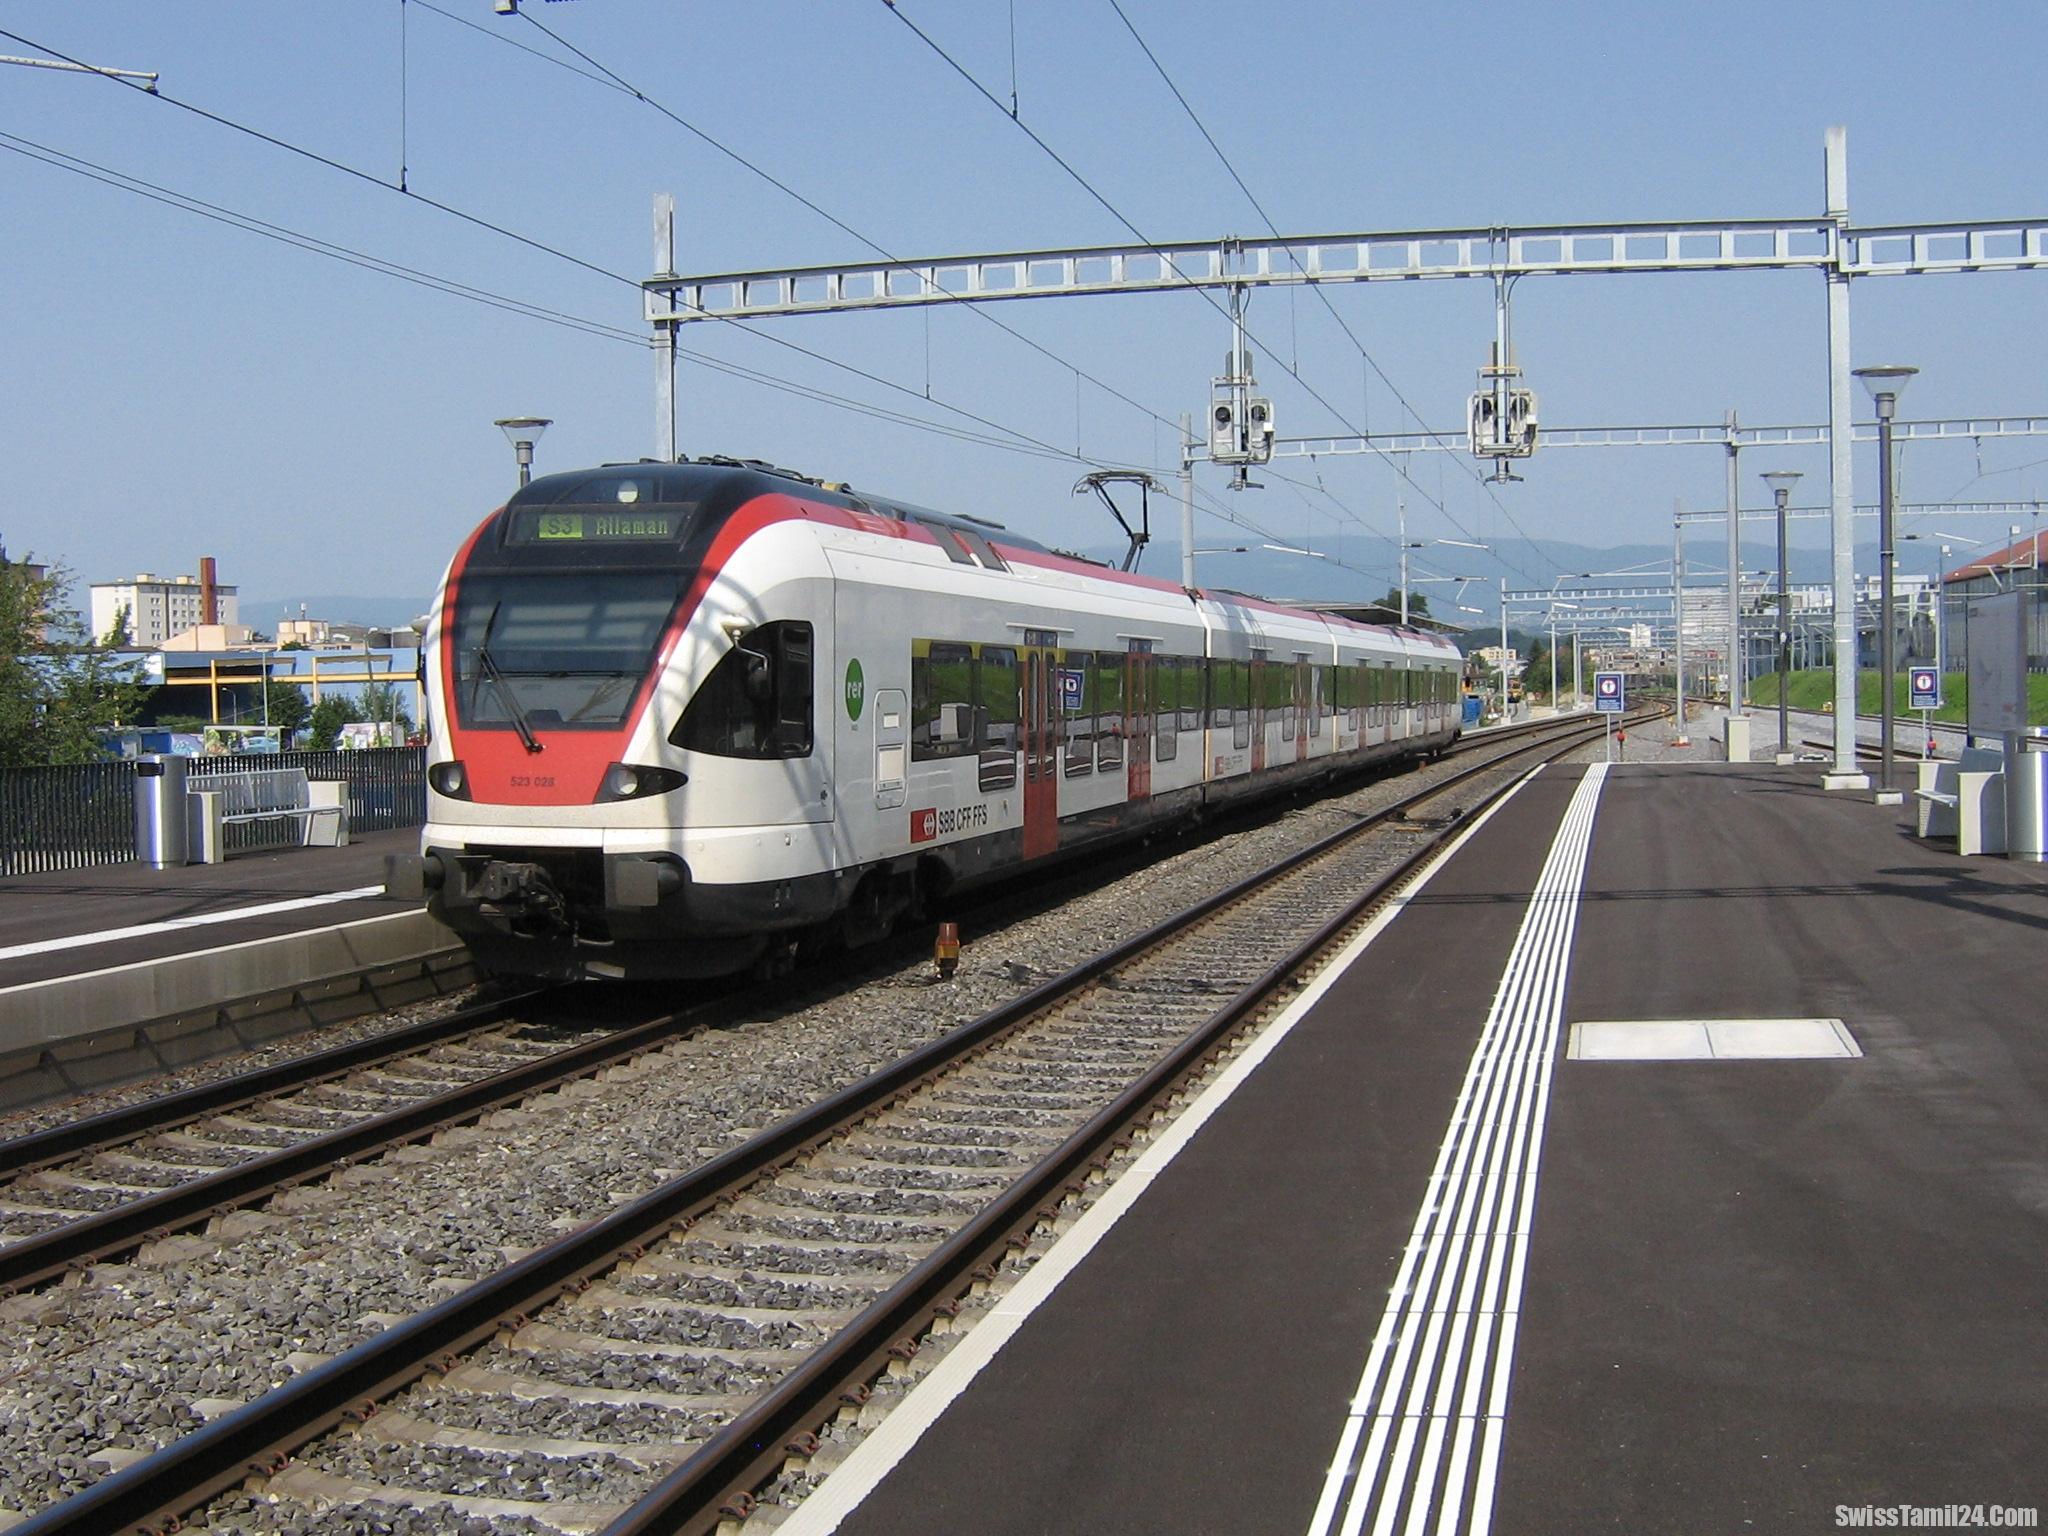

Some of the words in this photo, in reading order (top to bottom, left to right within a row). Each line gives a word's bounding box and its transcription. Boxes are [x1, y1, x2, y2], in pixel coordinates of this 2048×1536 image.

[547, 516, 573, 536] S3
[595, 517, 668, 536] Allaman
[847, 681, 863, 699] rer
[510, 776, 530, 787] 523
[938, 810, 955, 834] SBB
[956, 806, 972, 831] CFF
[973, 804, 988, 827] FFS
